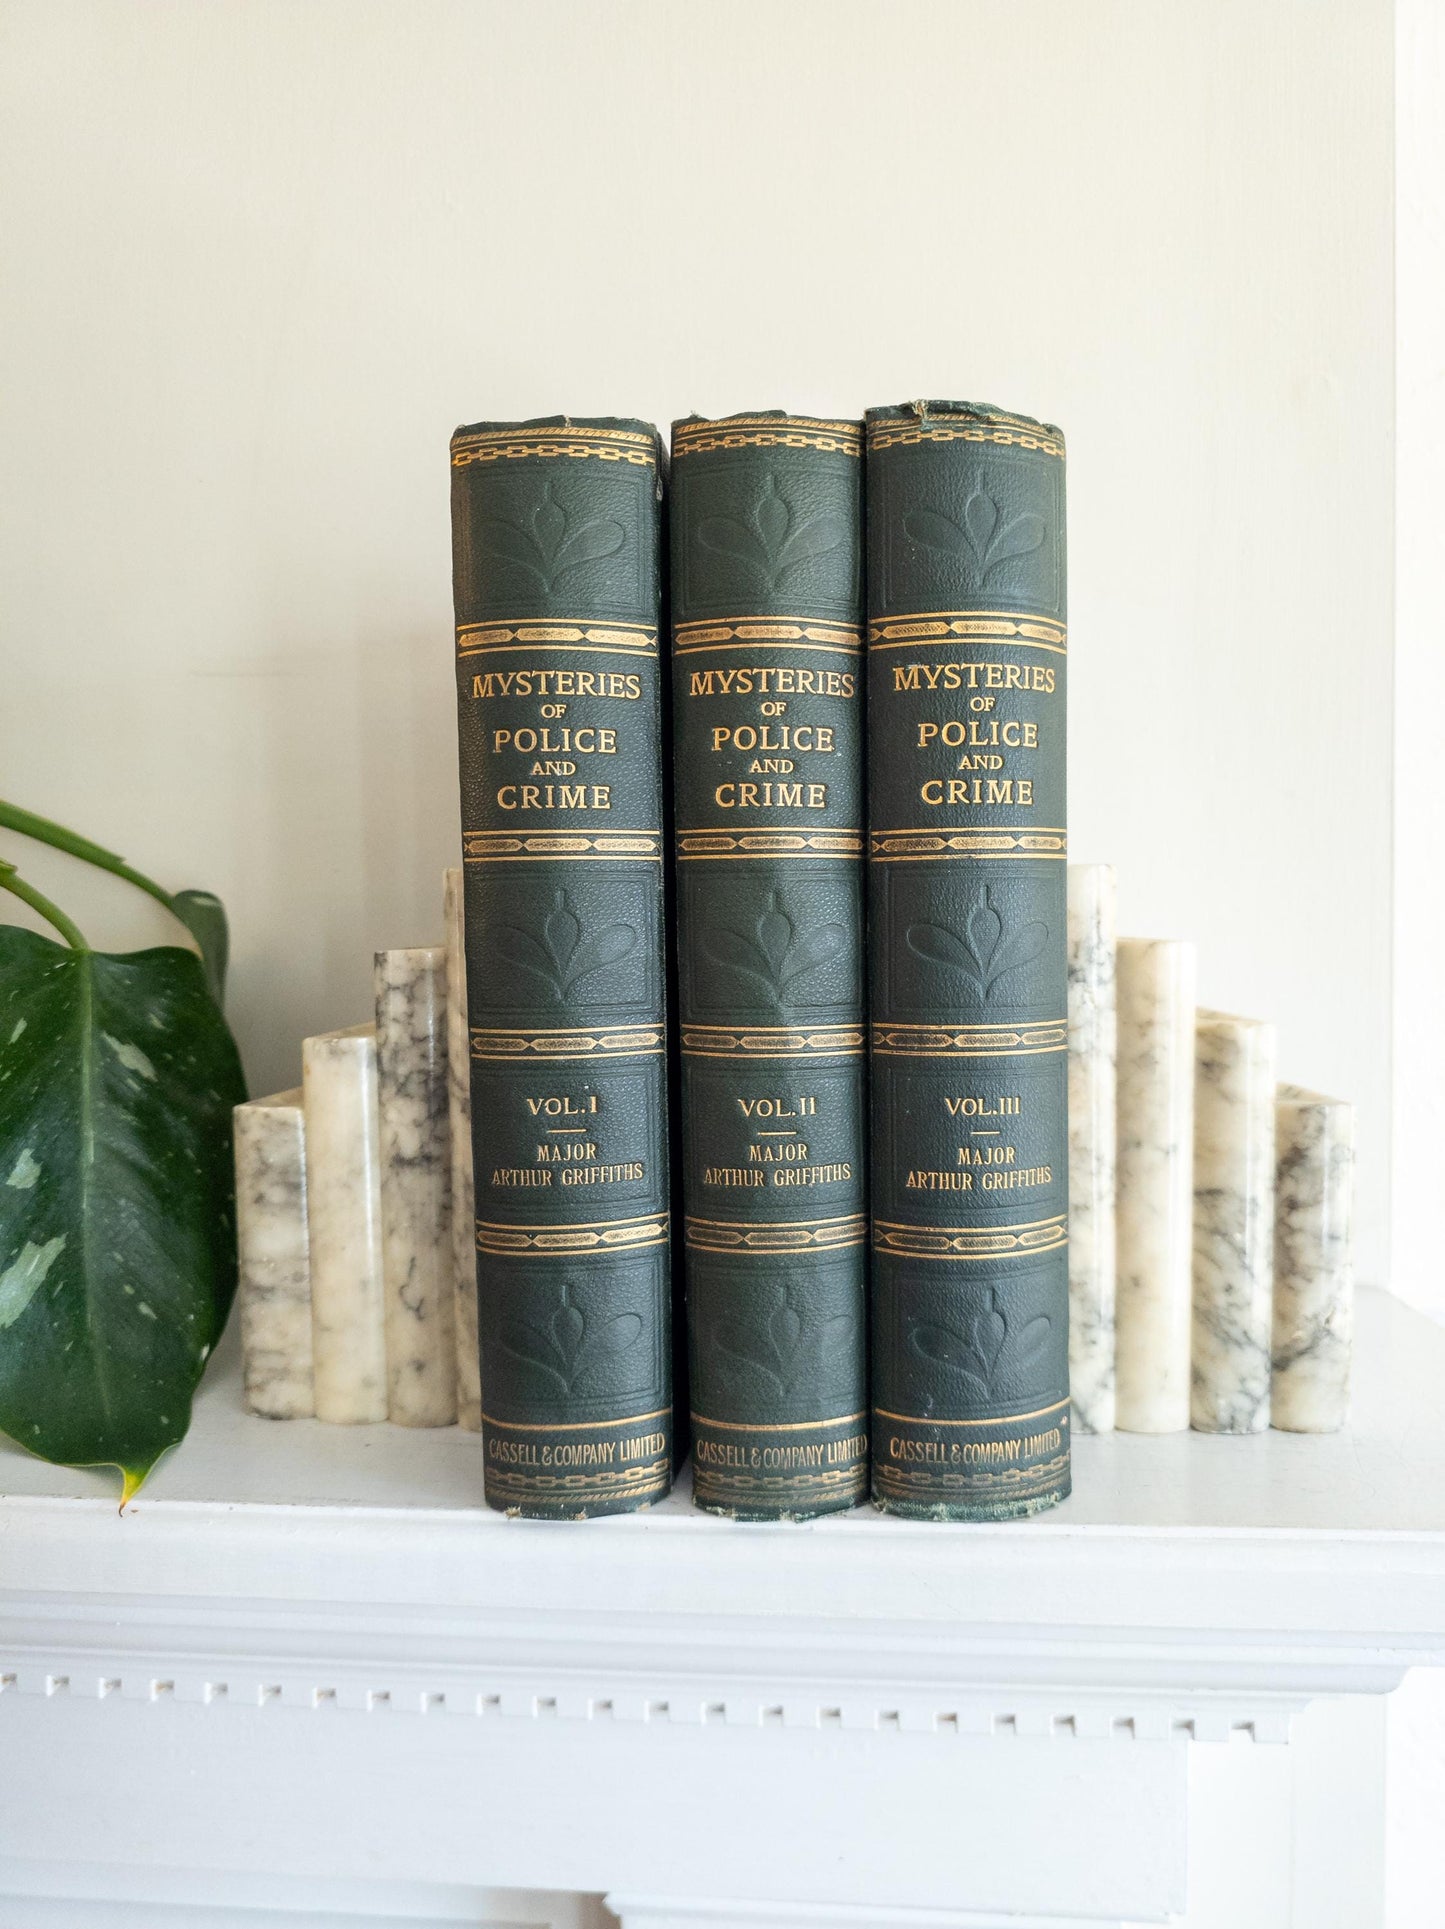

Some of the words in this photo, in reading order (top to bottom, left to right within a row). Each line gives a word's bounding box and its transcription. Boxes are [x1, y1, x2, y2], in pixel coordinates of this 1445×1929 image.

[472, 670, 641, 699] MYSTERIES
[690, 668, 855, 697] MYSTERIES
[893, 663, 1055, 693] MYSTERIES
[541, 704, 567, 719] OF
[761, 702, 787, 716] OF
[970, 697, 995, 711] OF
[493, 728, 617, 753] POLICE
[712, 726, 834, 752] POLICE
[918, 721, 1038, 748] POLICE
[532, 761, 576, 776] AND
[750, 759, 794, 774] AND
[959, 755, 1003, 770] AND
[497, 785, 611, 810] CRIME
[715, 783, 827, 808] CRIME
[921, 779, 1033, 805] CRIME
[536, 1143, 597, 1162] MAJOR
[749, 1143, 808, 1162] MAJOR
[957, 1146, 1015, 1166] MAJOR
[491, 1168, 552, 1187] ARTHUR
[562, 1162, 644, 1186] GRIFFITHS
[703, 1167, 765, 1187] ARTHUR
[774, 1163, 852, 1187] GRIFFITHS
[905, 1170, 973, 1190] ARTHUR
[981, 1166, 1052, 1190] GRIFFITHS
[488, 1438, 540, 1466] CASSELL
[619, 1432, 666, 1461] LIMITED
[696, 1439, 749, 1468] CASSELL
[827, 1433, 868, 1463] LIMITED
[889, 1436, 949, 1464] CASSELL
[1023, 1428, 1061, 1458] LIMITED
